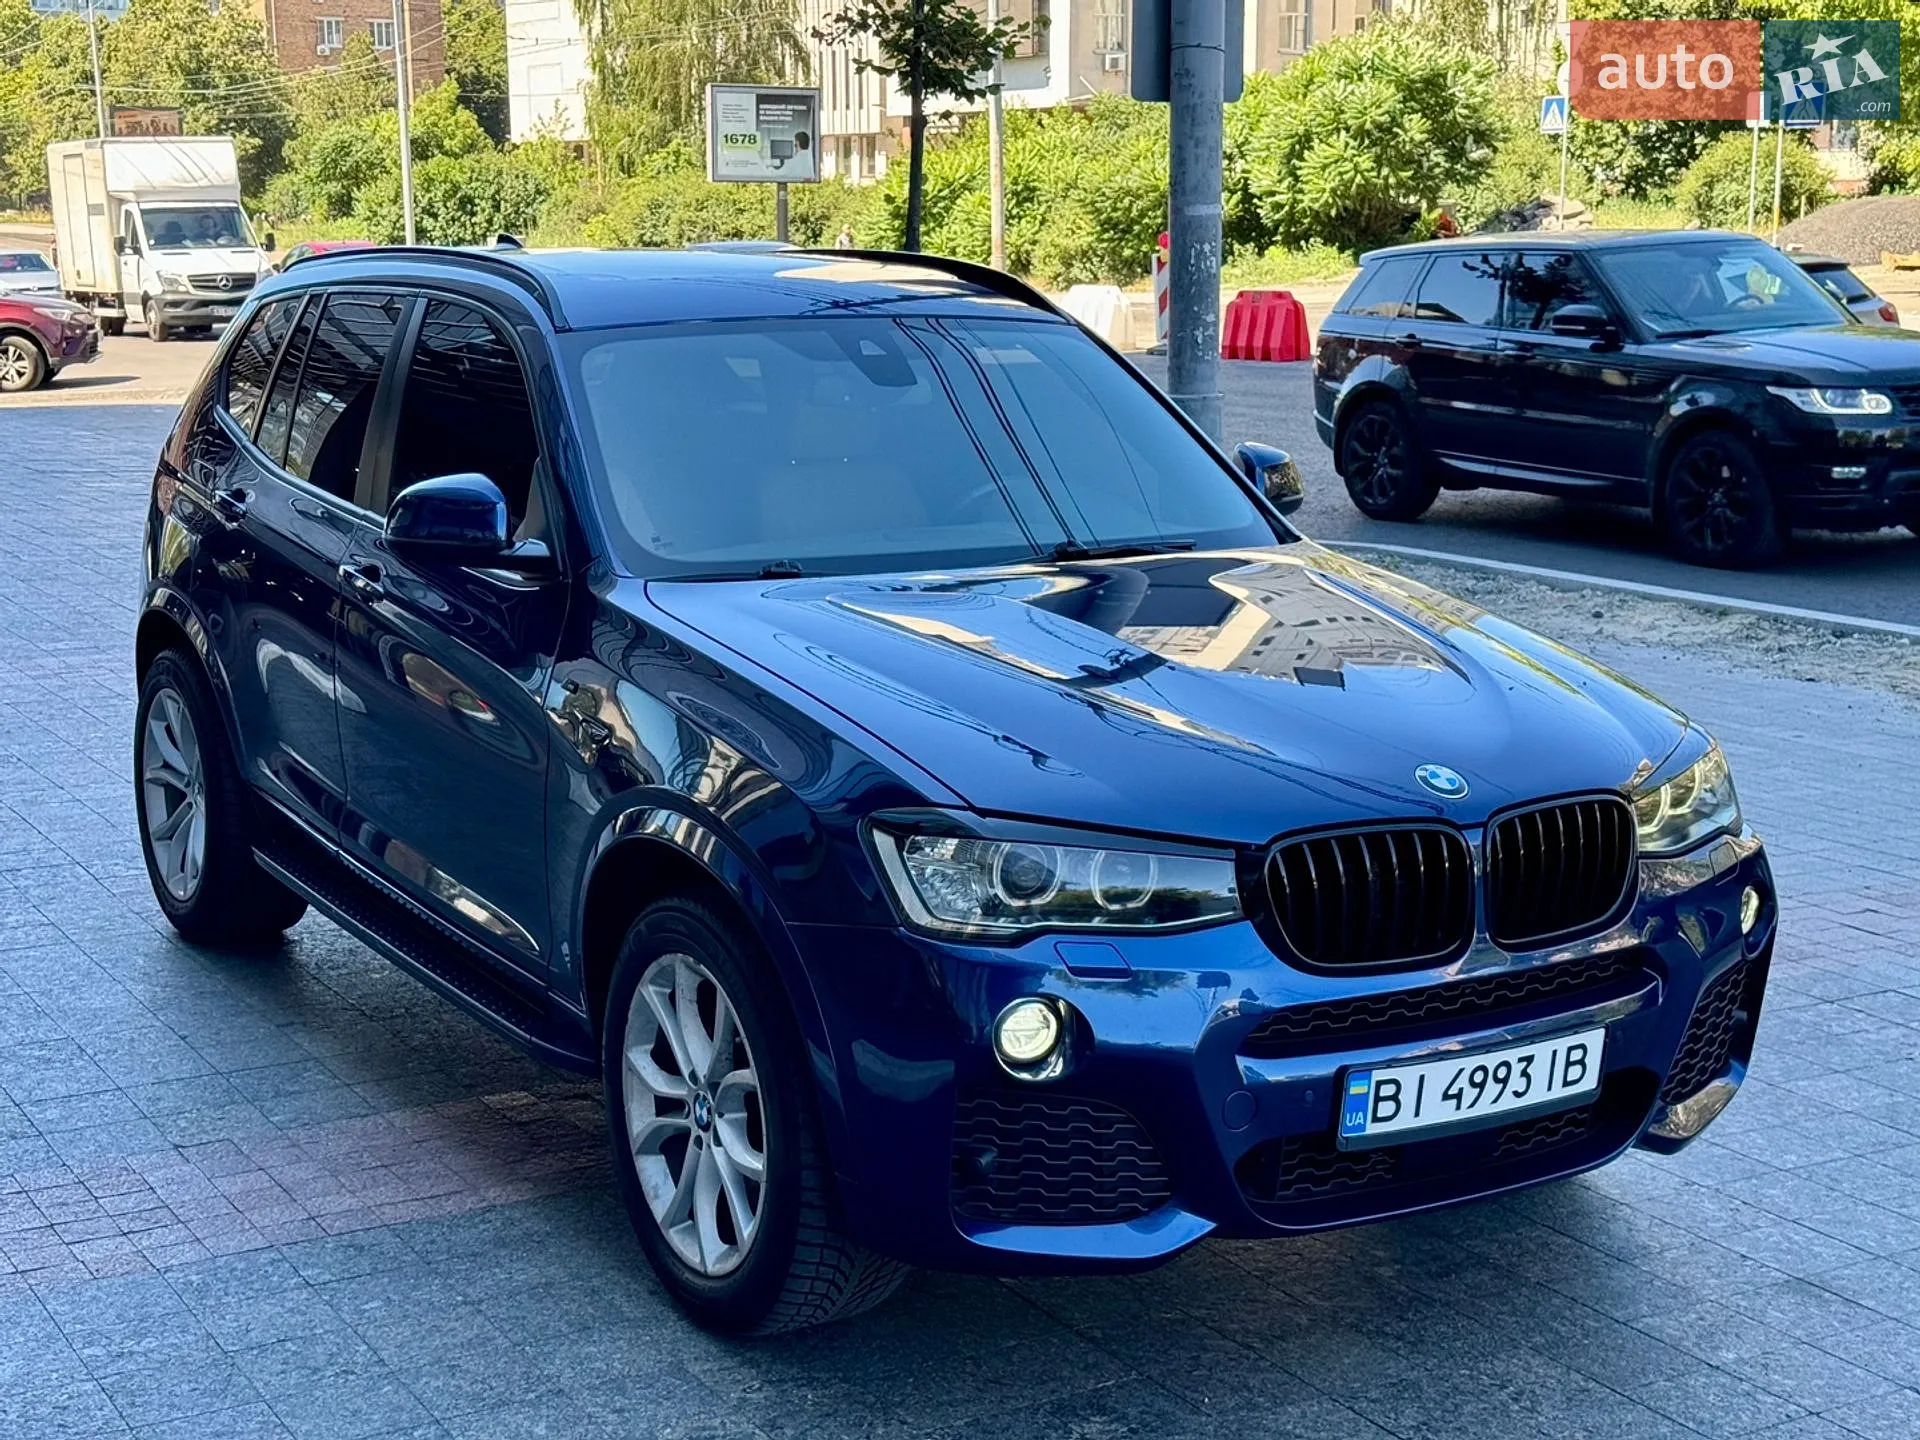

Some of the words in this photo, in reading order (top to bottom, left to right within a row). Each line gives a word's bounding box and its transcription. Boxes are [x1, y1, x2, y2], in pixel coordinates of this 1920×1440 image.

[723, 133, 757, 145] 1678
[1370, 1074, 1425, 1124] BI
[1441, 1053, 1535, 1111] 4993
[1546, 1043, 1588, 1092] IB
[1346, 1112, 1365, 1127] UA
